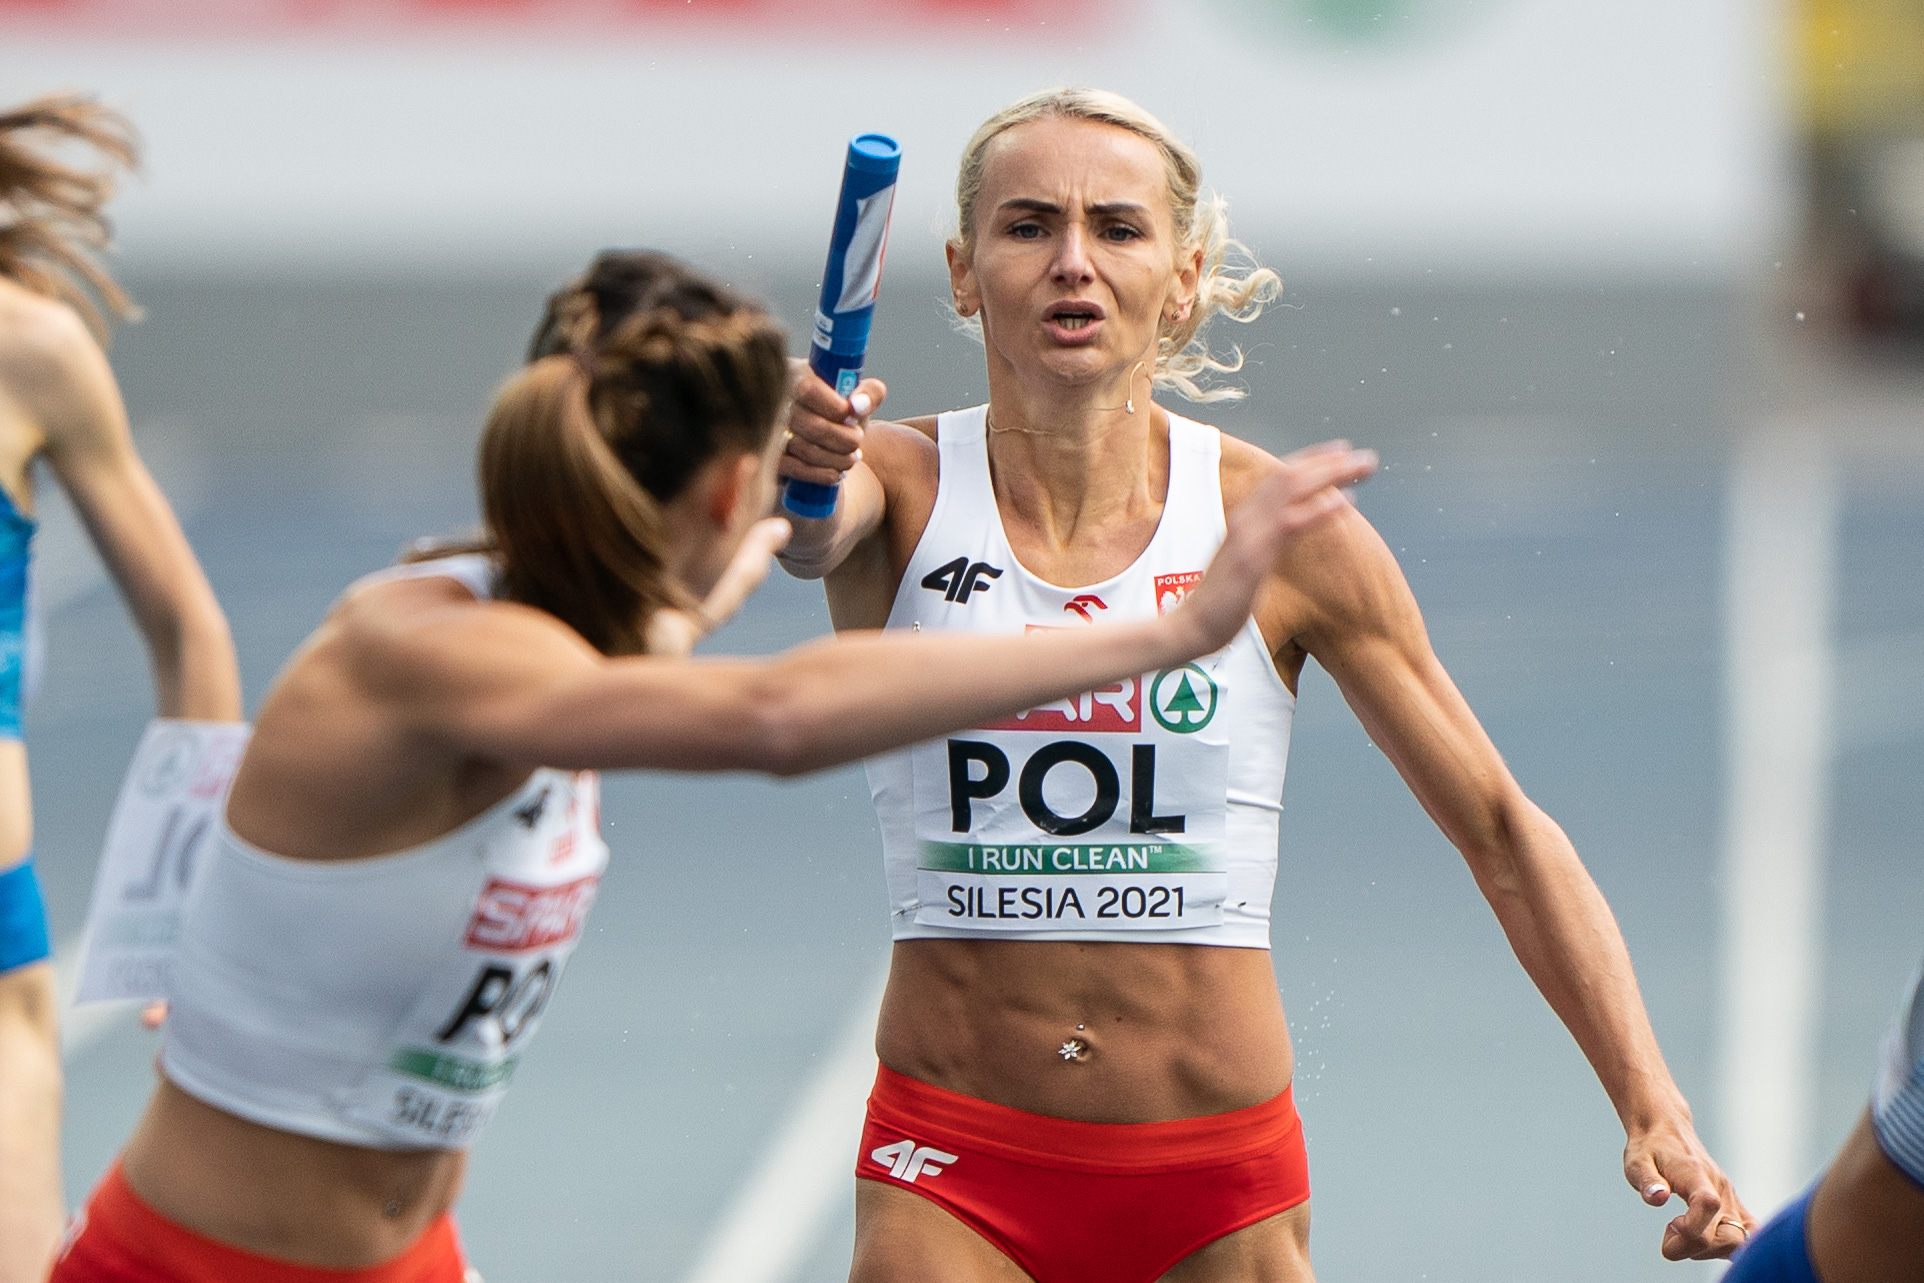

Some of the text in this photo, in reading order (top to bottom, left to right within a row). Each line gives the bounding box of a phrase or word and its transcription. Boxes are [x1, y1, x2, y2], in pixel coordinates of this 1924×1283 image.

[921, 556, 1004, 605] 4F
[1157, 573, 1201, 586] POLSKA
[947, 738, 1187, 837] POL
[967, 847, 975, 870] I
[982, 847, 1043, 871] RUN
[947, 884, 1184, 919] SILESIA 2021
[435, 959, 555, 1045] PO
[871, 1139, 959, 1184] 4F
